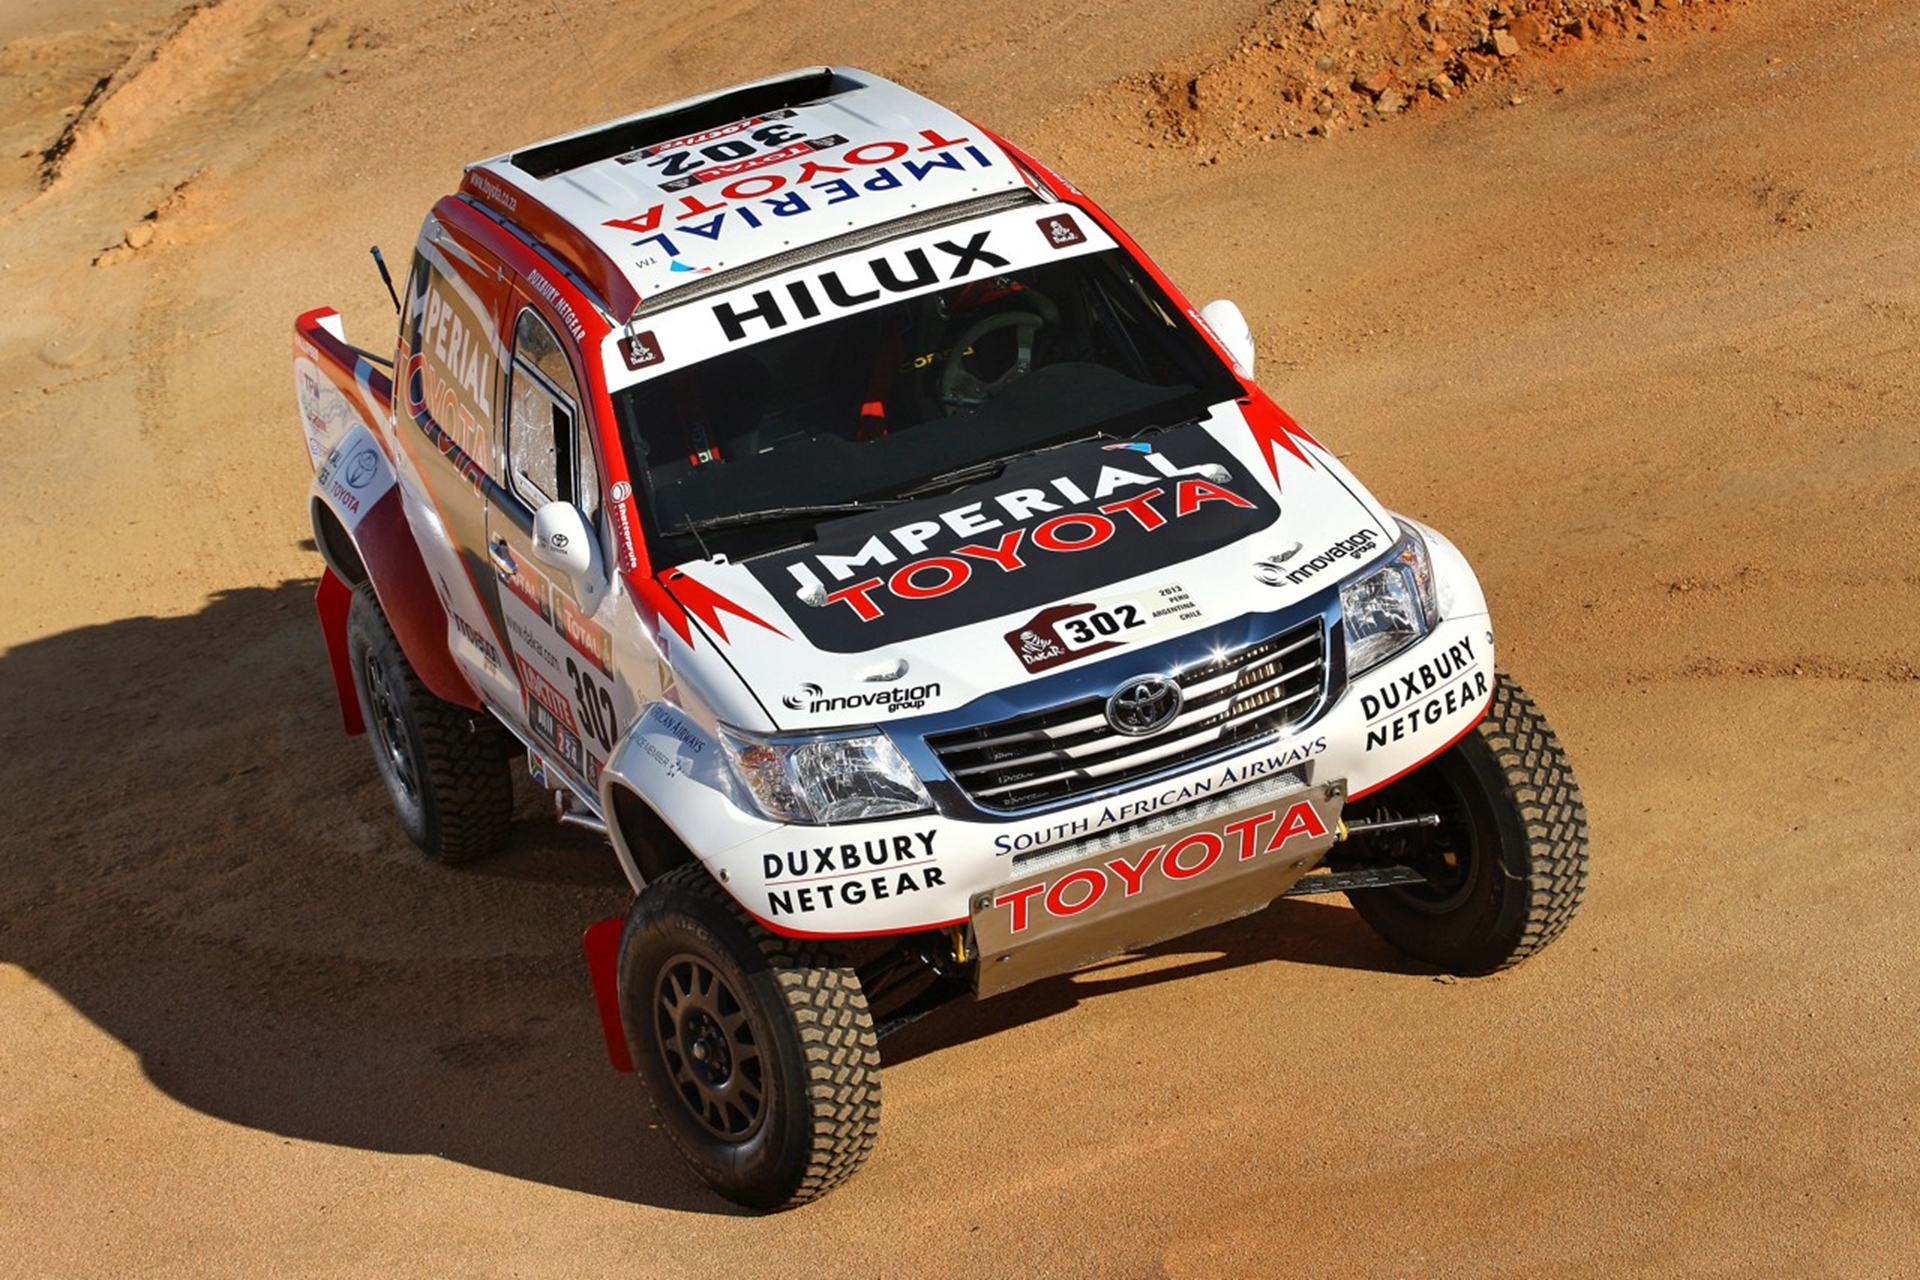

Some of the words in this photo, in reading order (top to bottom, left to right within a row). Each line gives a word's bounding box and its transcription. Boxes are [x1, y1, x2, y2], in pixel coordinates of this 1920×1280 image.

[647, 124, 807, 176] 302
[697, 145, 809, 178] TOTAL
[601, 129, 970, 232] TOYOTA
[632, 145, 992, 257] IMPERIAL
[527, 269, 561, 303] DUXBURY
[556, 297, 587, 344] NETGEAR
[711, 230, 1011, 342] HILUX
[330, 480, 360, 515] TOYOTA
[785, 452, 1206, 588] IMPERIAL
[824, 479, 1258, 622] TOYOTA
[1285, 528, 1379, 585] innovation
[1151, 601, 1196, 618] ARGENTINA
[1159, 585, 1183, 597] 2013
[1169, 593, 1190, 604] PERU
[1179, 610, 1203, 621] CHILE
[564, 608, 602, 660] TOTAL
[1065, 604, 1147, 644] 302
[809, 682, 941, 713] innovation
[1360, 635, 1475, 721] DUXBURY
[566, 656, 618, 754] 302
[888, 699, 925, 714] group
[1366, 671, 1488, 752] NETGEAR
[671, 720, 706, 754] AIRWAYS
[994, 818, 1089, 856] SOUTH
[1096, 778, 1212, 828] AFRICAN
[1218, 736, 1327, 788] AIRWAYS
[763, 829, 937, 880] DUXBURY
[994, 799, 1330, 934] TOYOTA
[767, 866, 946, 916] NETGEAR
